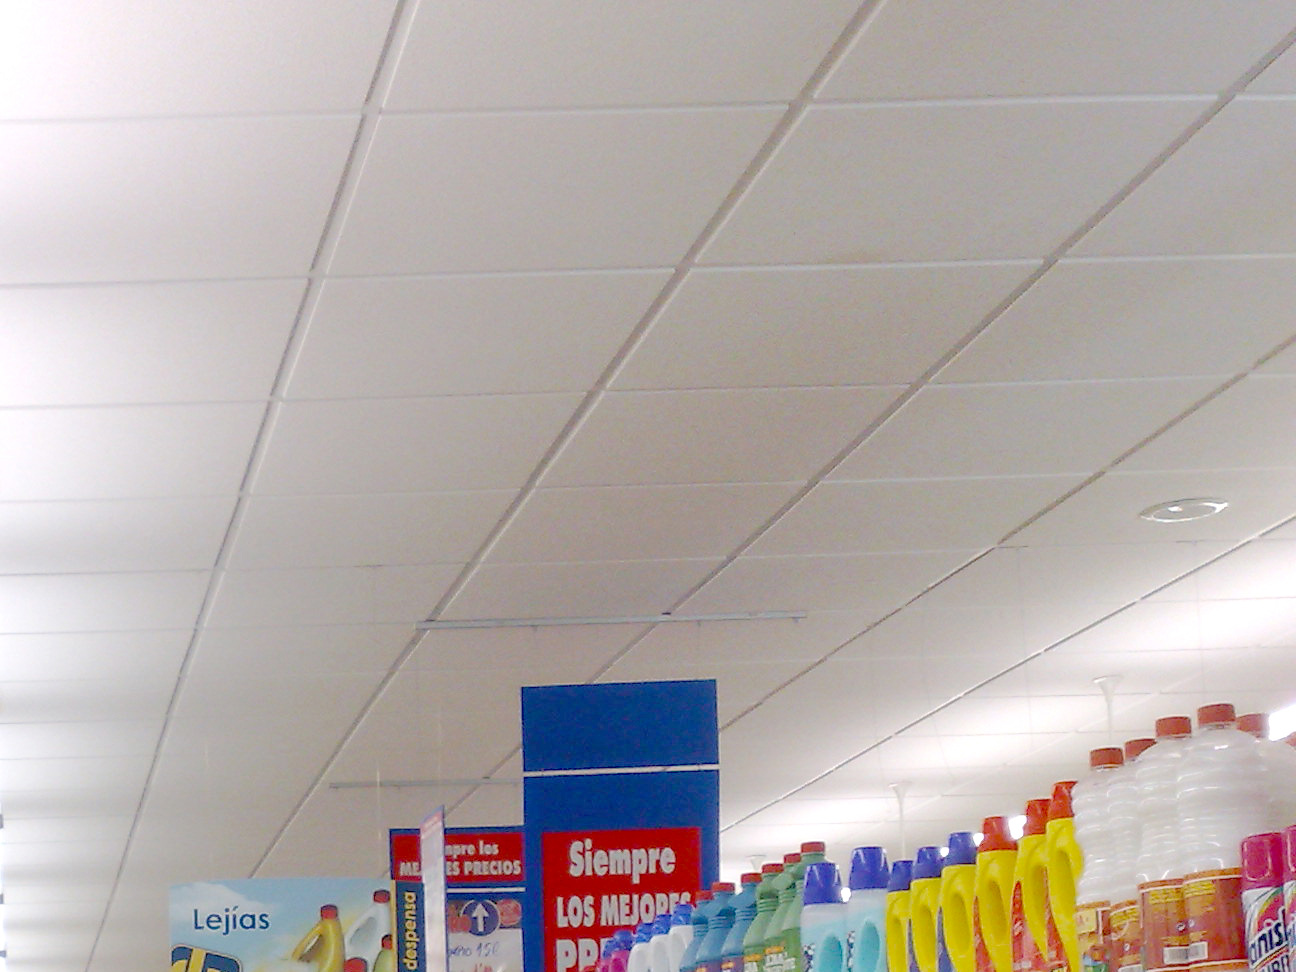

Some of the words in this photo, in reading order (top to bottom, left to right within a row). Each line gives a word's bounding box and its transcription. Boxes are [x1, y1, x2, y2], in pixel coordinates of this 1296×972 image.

[464, 860, 522, 876] PRECIOS
[569, 838, 676, 884] Siempre
[193, 907, 271, 935] Lejías
[556, 895, 595, 928] LOS
[404, 890, 421, 969] despensa
